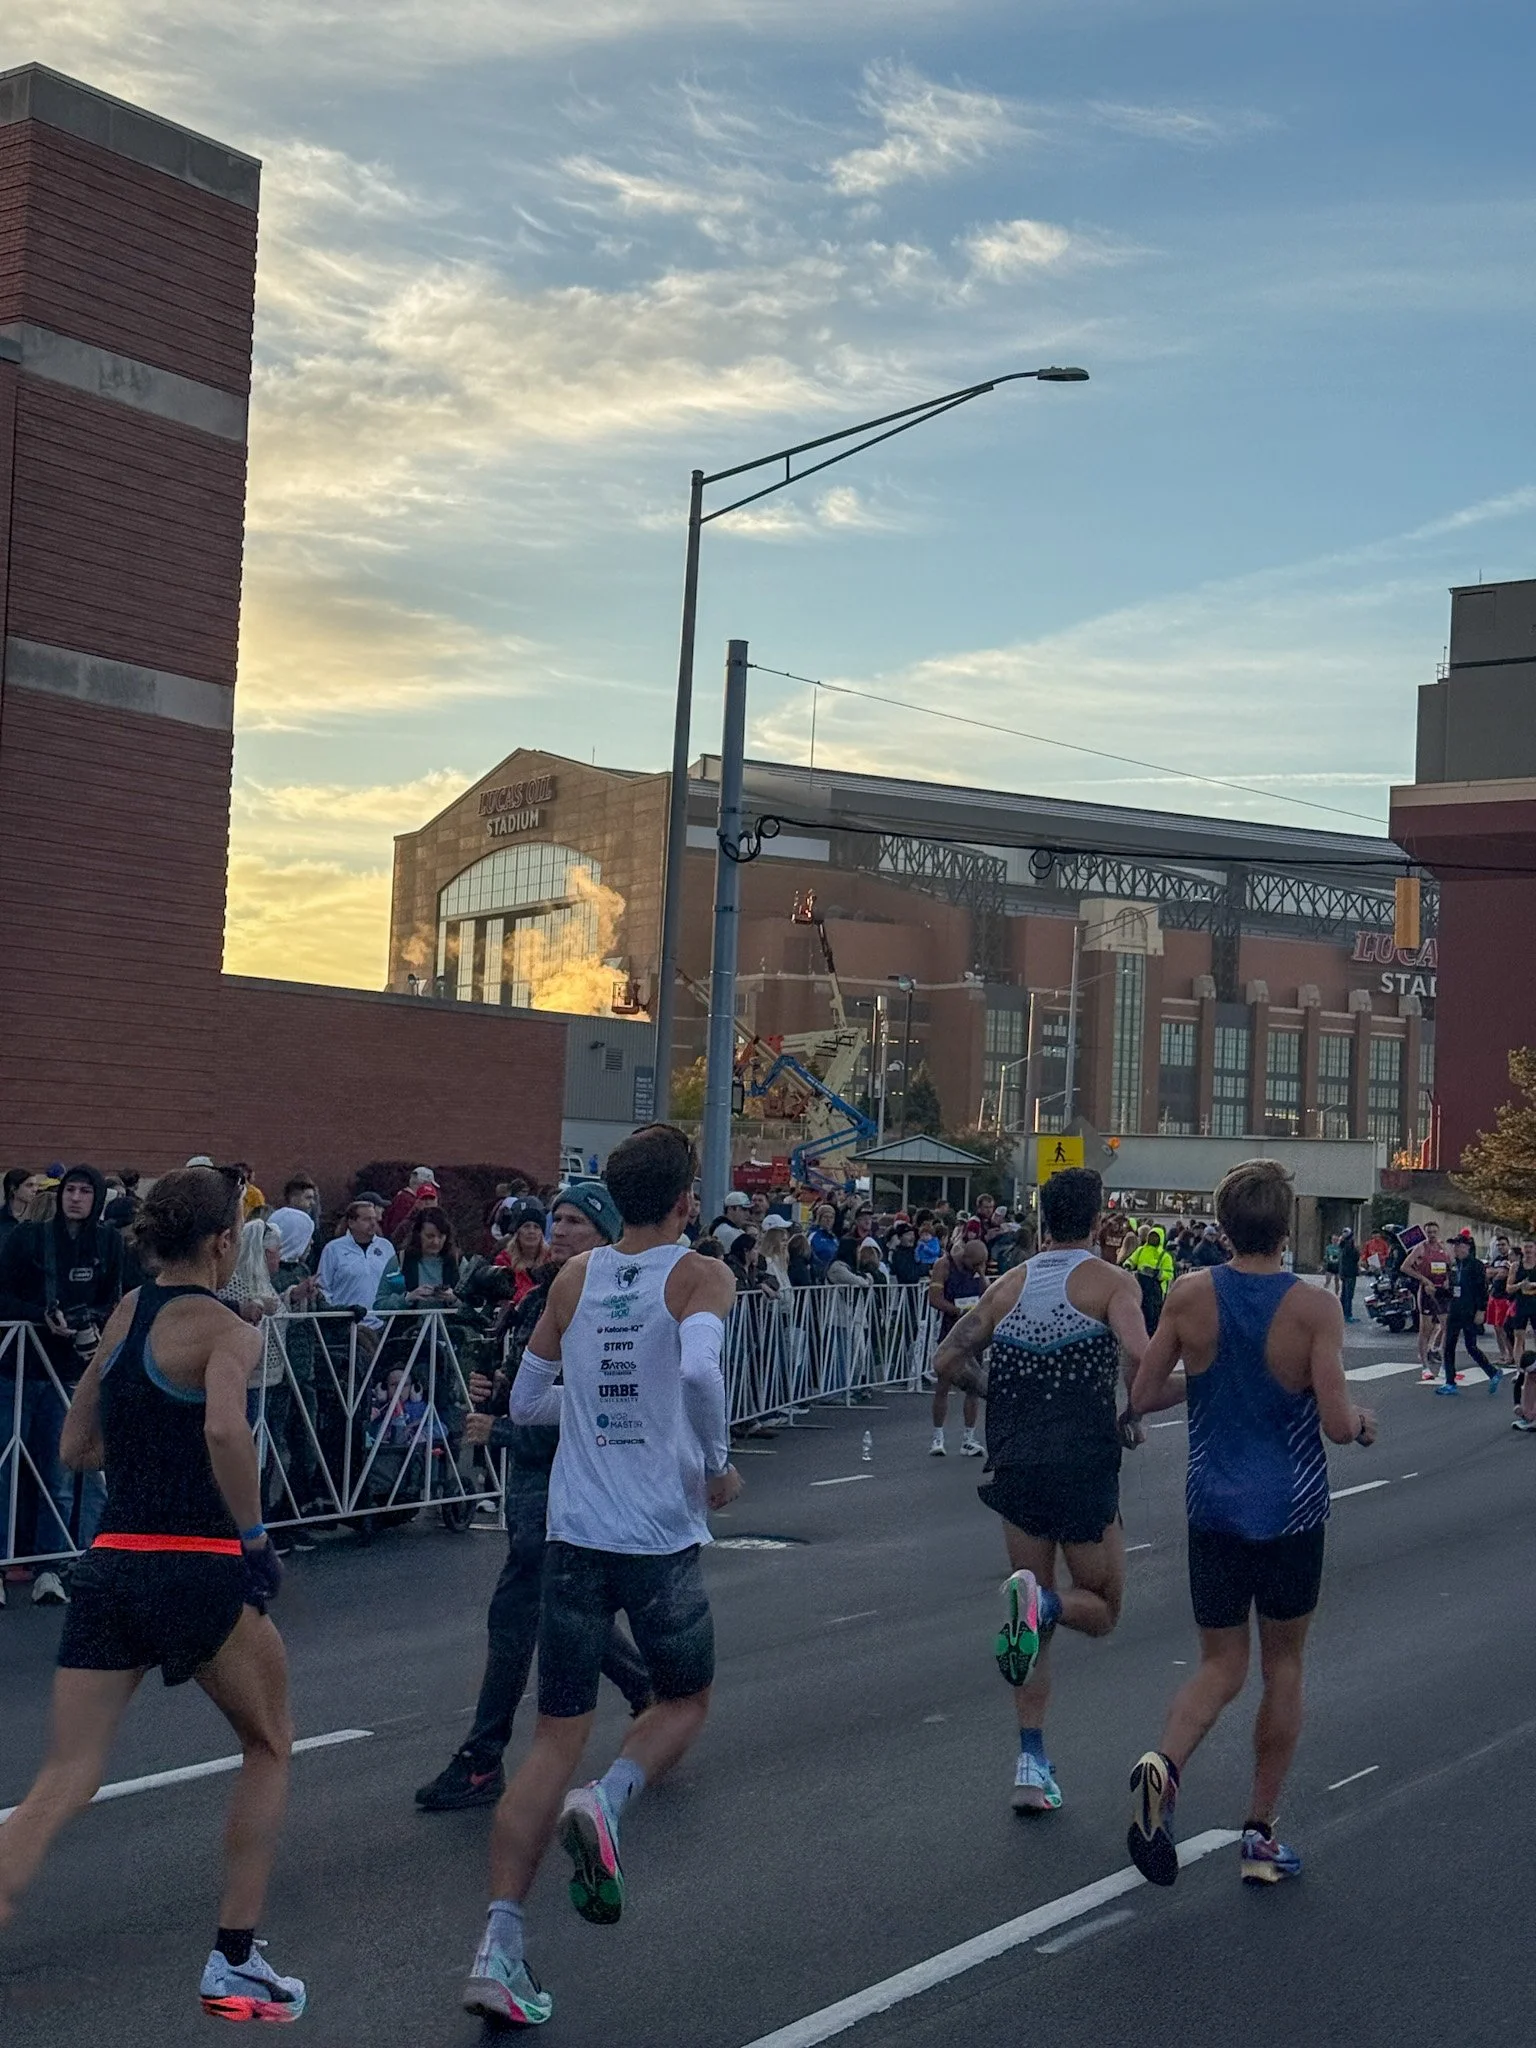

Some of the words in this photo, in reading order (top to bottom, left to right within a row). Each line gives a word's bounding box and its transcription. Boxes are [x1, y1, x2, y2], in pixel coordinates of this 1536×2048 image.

[478, 781, 523, 816] LUCAS
[526, 775, 553, 805] OIL
[487, 809, 539, 837] STADIUM
[603, 1341, 634, 1351] STRYD
[598, 1384, 639, 1397] URBE
